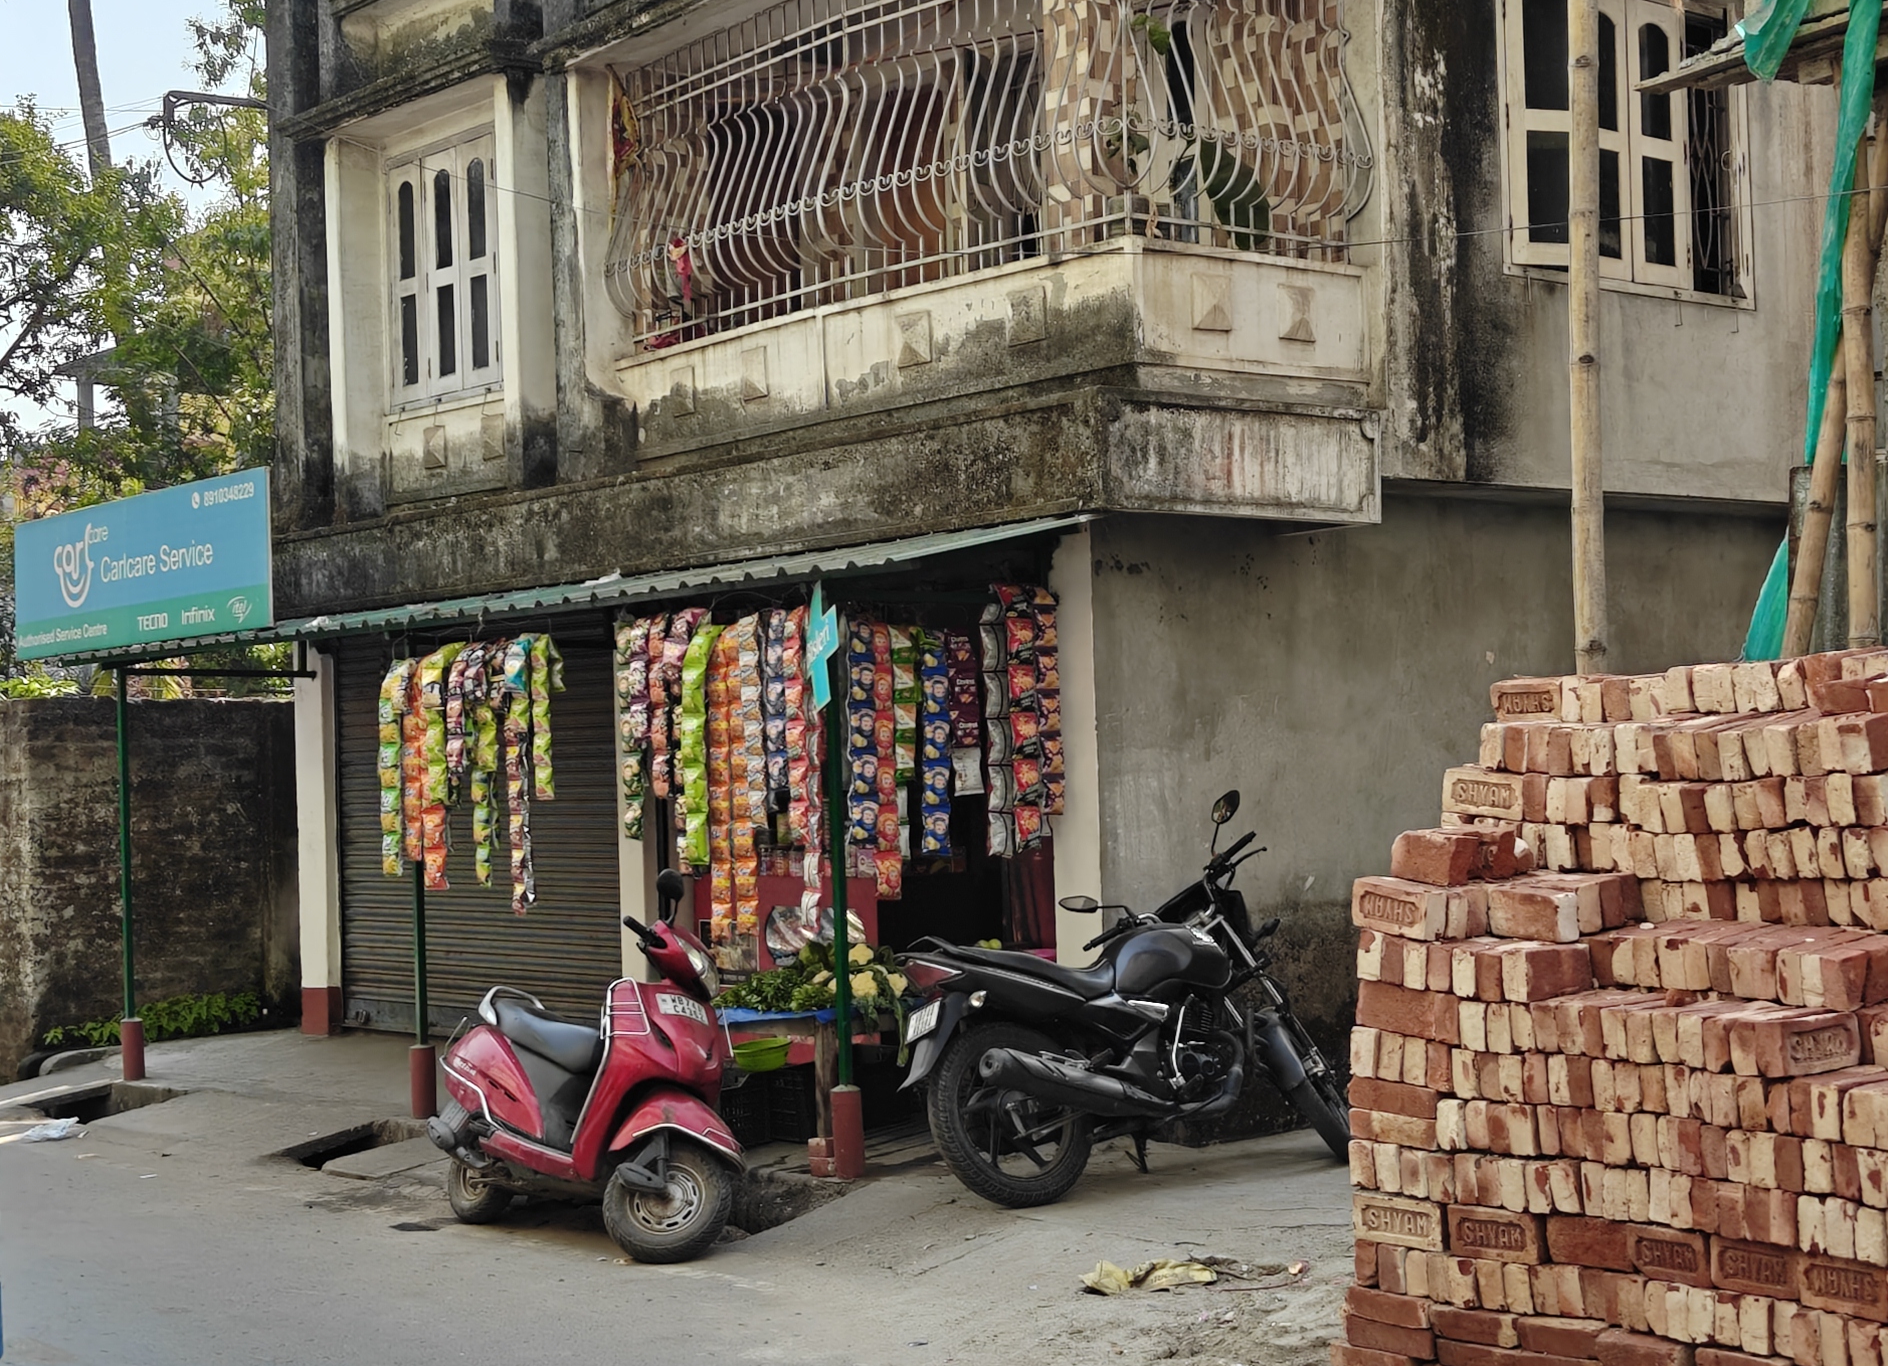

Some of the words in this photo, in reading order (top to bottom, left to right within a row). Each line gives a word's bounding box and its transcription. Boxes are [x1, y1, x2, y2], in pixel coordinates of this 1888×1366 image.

[100, 553, 156, 583] Carlcare
[159, 539, 213, 572] Service
[137, 612, 168, 632] TECNO
[181, 605, 215, 625] Infinix
[55, 626, 82, 642] Service
[1458, 782, 1512, 808] SHYAM
[1365, 894, 1416, 923] SHYAM
[1368, 1208, 1428, 1236] SHYAM
[1463, 1221, 1523, 1249] SHYAM
[1640, 1239, 1699, 1273] SHYAM
